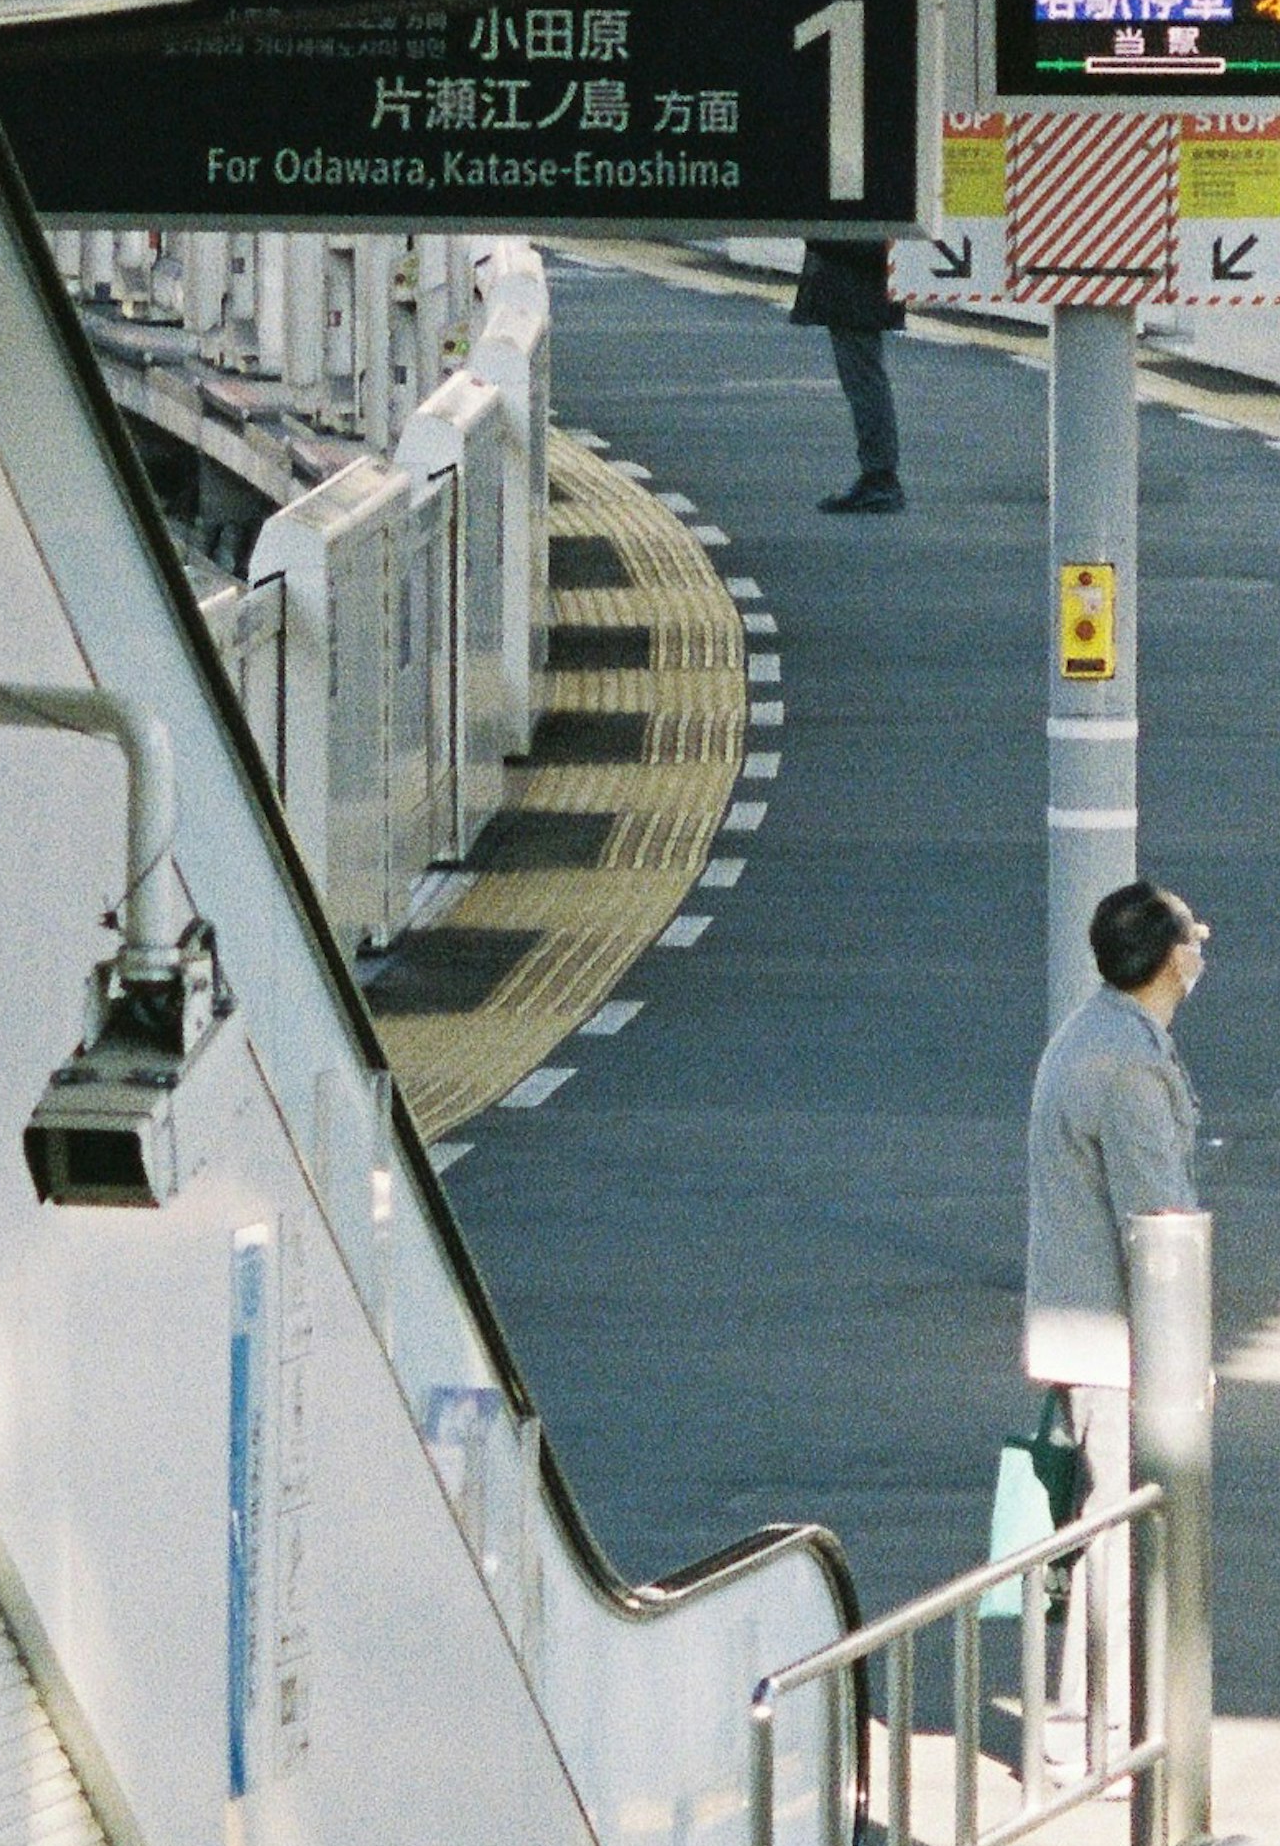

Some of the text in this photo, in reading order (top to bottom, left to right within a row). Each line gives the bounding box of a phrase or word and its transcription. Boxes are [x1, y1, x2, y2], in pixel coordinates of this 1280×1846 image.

[469, 8, 632, 62] 小田原
[1114, 26, 1200, 56] 当駅
[369, 75, 741, 134] 片瀬江ノ島 方面
[792, 0, 867, 201] 1
[207, 148, 741, 189] For Odawara, Katase-Enoshima
